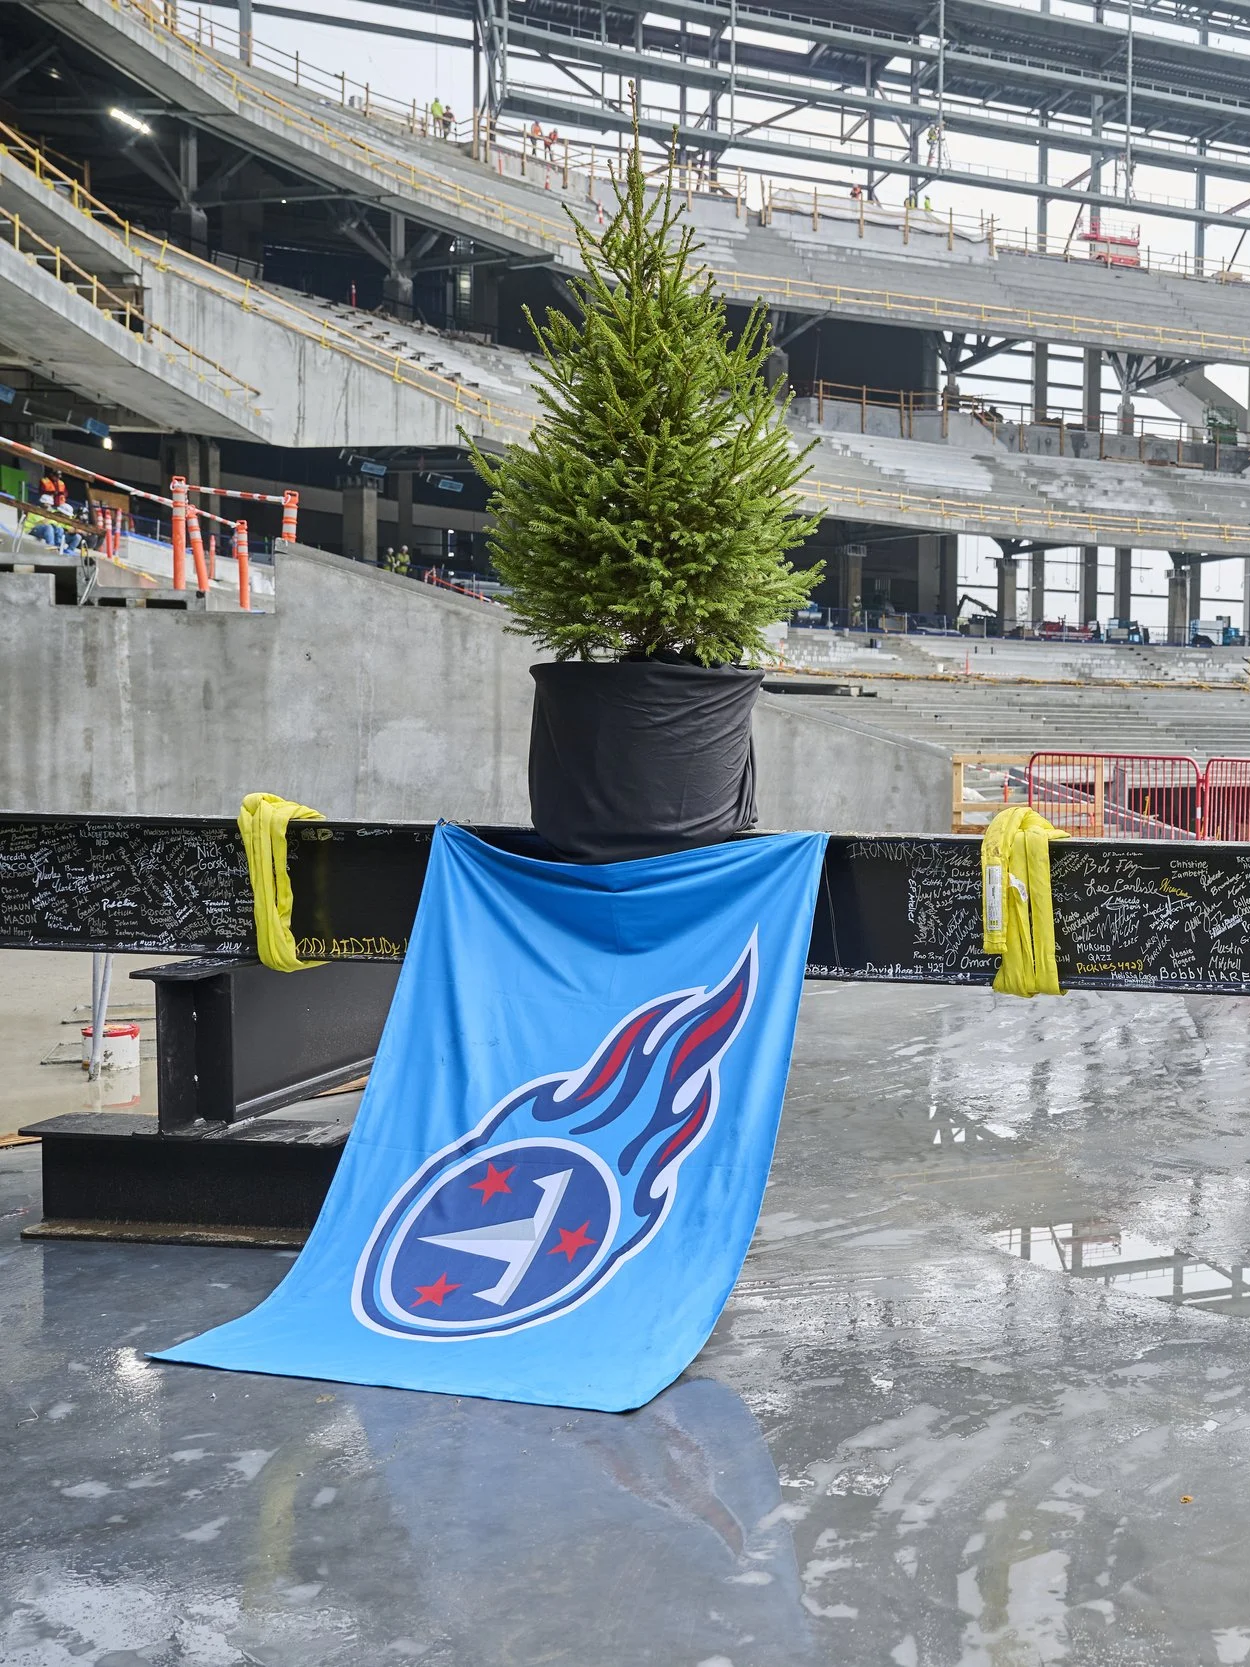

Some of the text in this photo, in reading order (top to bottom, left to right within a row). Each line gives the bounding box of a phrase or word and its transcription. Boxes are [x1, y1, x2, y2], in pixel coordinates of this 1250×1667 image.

[85, 848, 117, 862] Jordan
[197, 846, 223, 860] Nick
[198, 857, 228, 871] Gorski
[1170, 860, 1209, 870] Christine
[2, 901, 31, 913] SHAUN
[4, 911, 37, 925] MASON
[1210, 939, 1243, 953] Austin
[1088, 953, 1112, 963] QAZI
[866, 962, 895, 973] David
[1208, 970, 1250, 981] HARE
